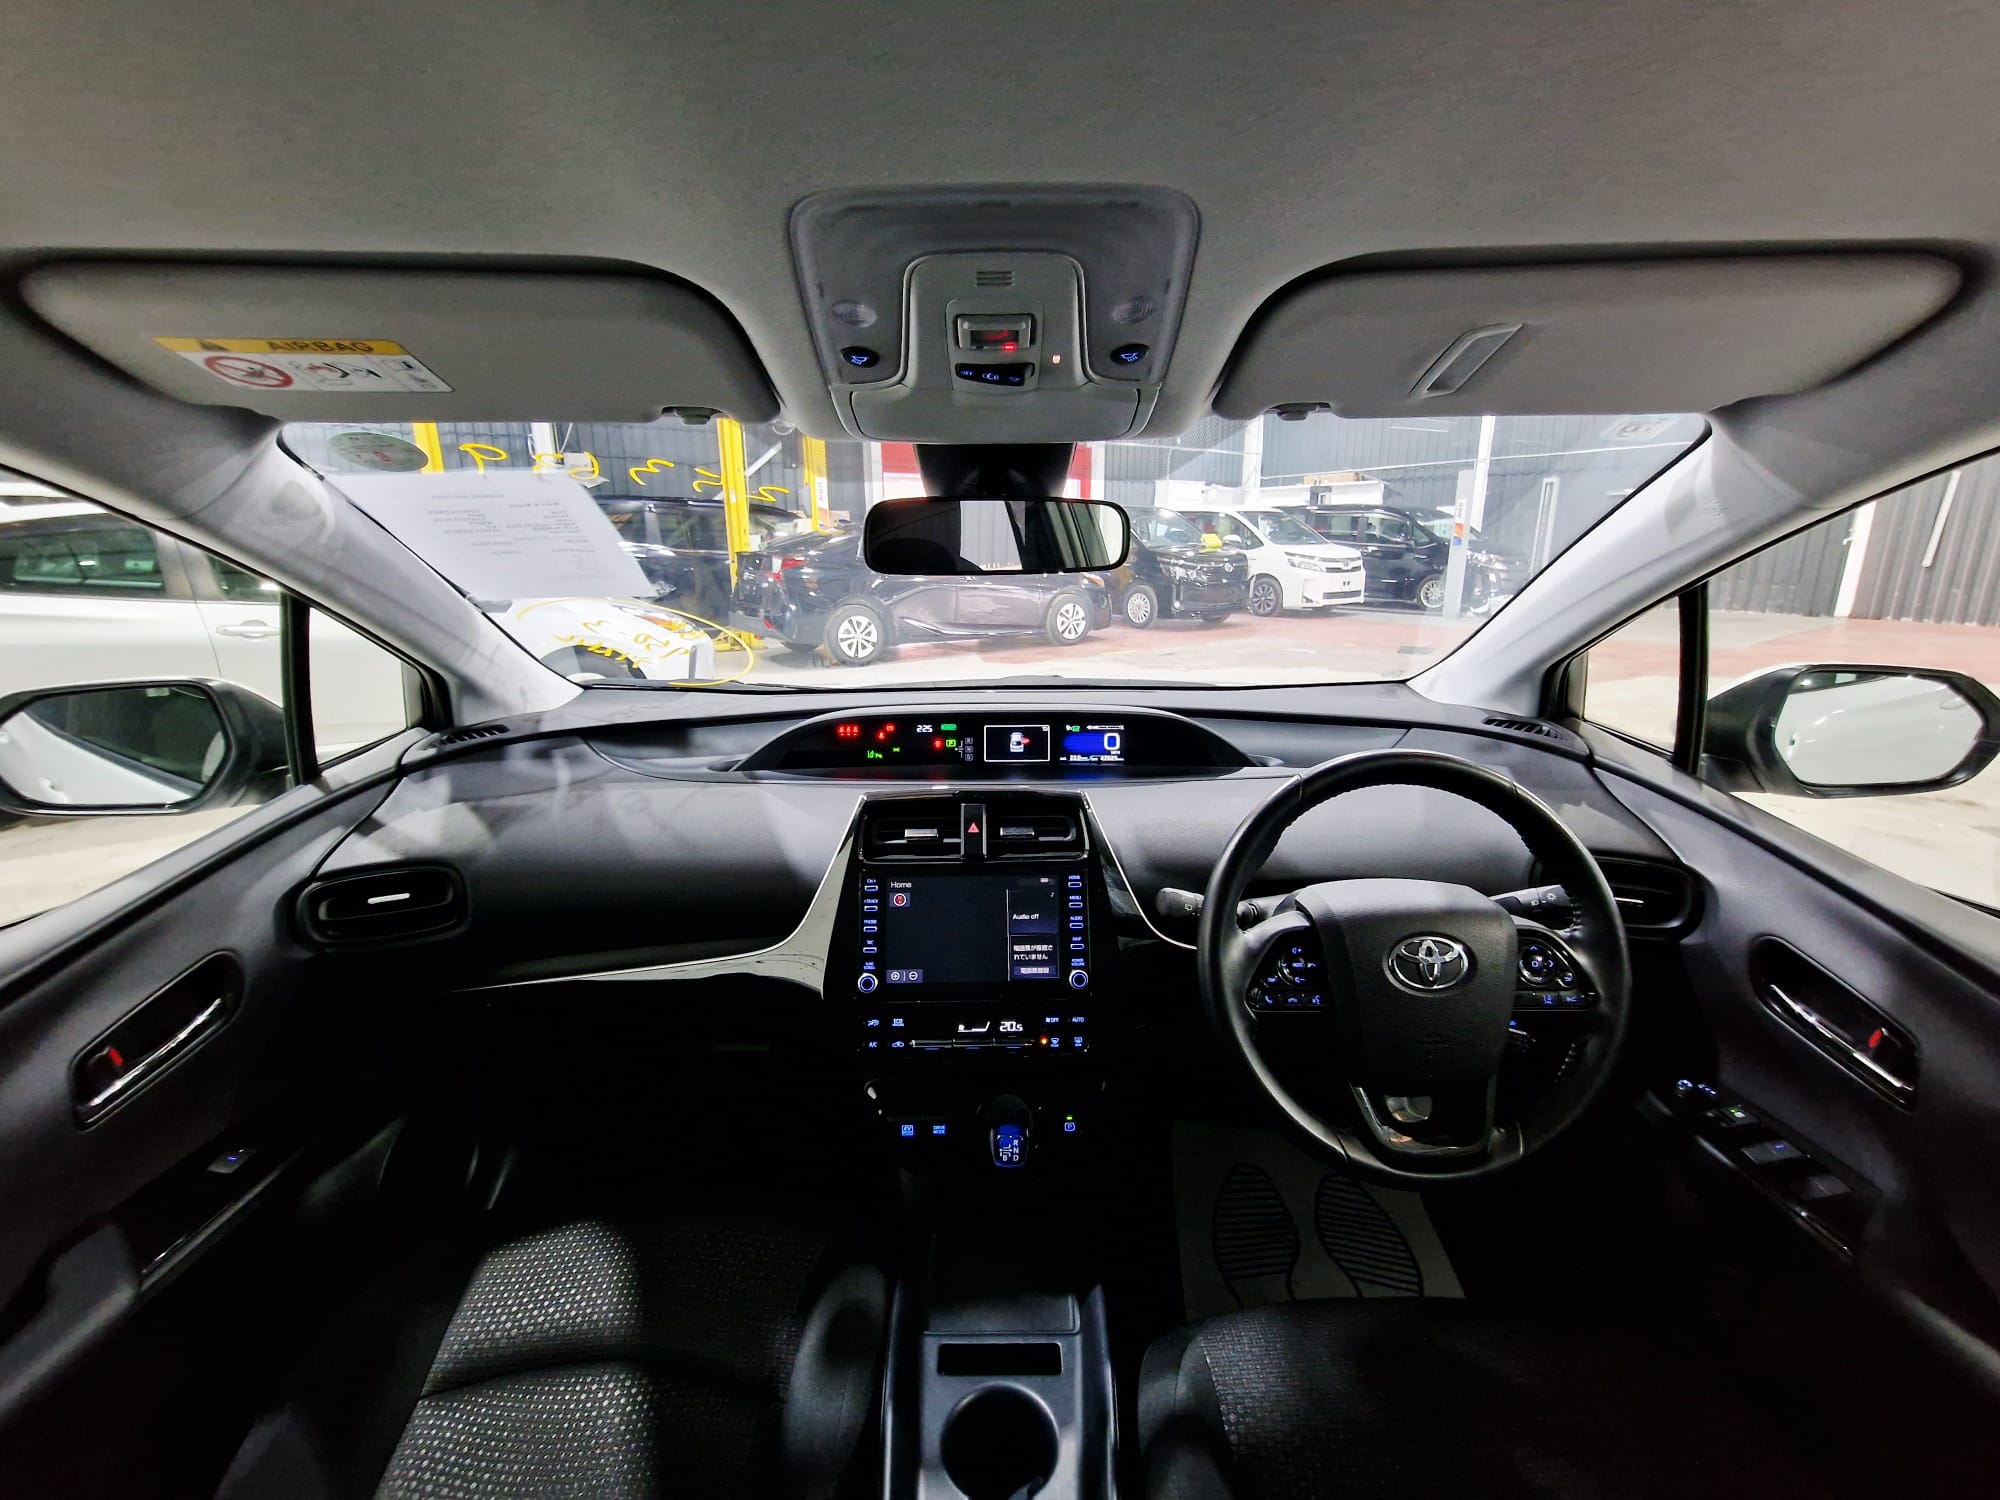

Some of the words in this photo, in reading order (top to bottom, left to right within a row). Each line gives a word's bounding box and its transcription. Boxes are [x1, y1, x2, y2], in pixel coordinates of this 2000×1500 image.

[266, 340, 375, 353] AIRBAG
[890, 881, 912, 889] Home
[1012, 1139, 1019, 1147] R
[1002, 1154, 1008, 1162] B
[1012, 1154, 1020, 1162] D
